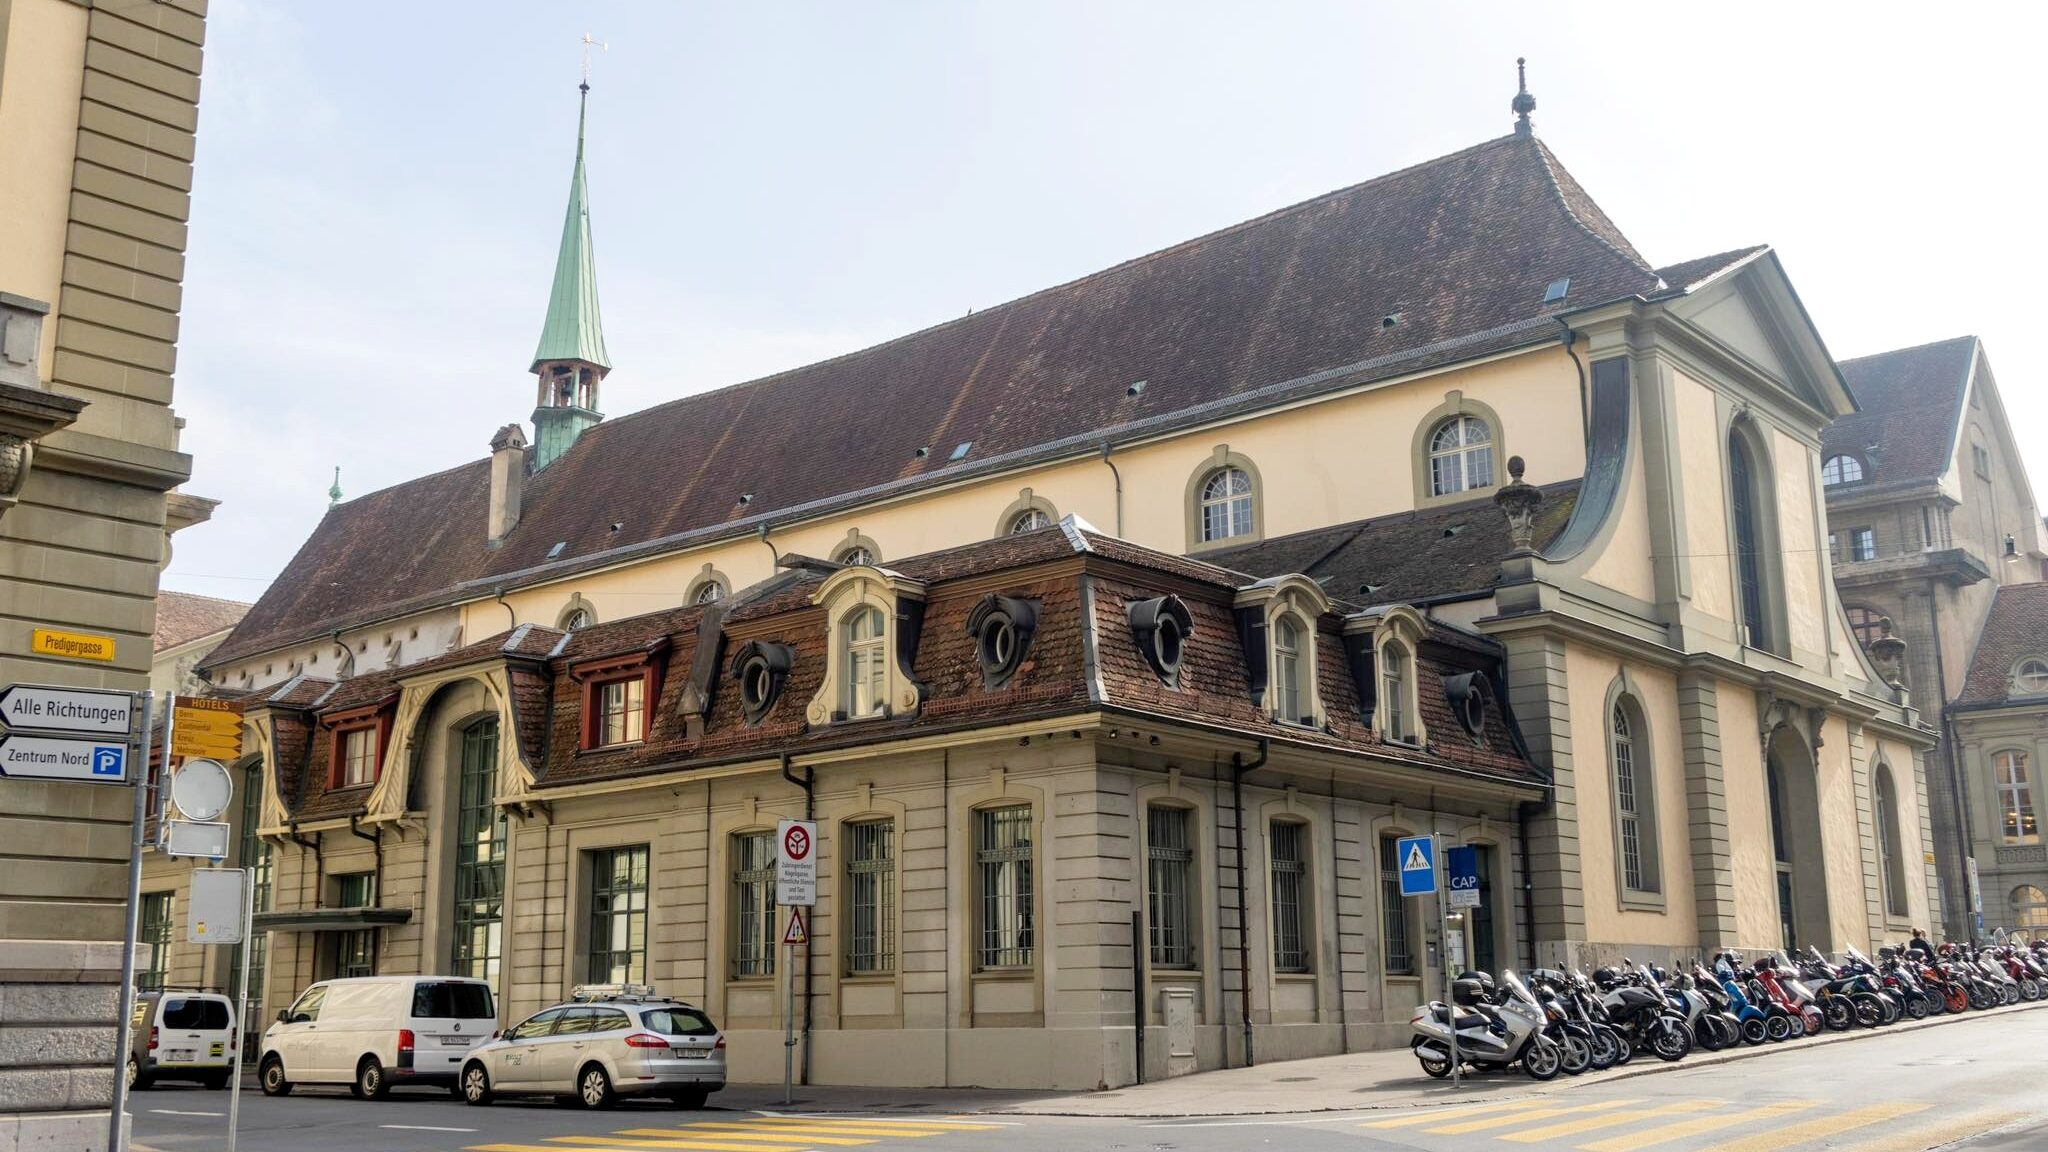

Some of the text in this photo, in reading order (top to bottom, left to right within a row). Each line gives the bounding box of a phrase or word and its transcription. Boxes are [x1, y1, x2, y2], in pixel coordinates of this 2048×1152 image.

[45, 635, 102, 655] Predigergasse
[13, 698, 126, 724] Alle Richtungen
[191, 699, 229, 710] HOTELS
[8, 749, 115, 772] Zentrum Nord P
[1451, 876, 1476, 889] CAP
